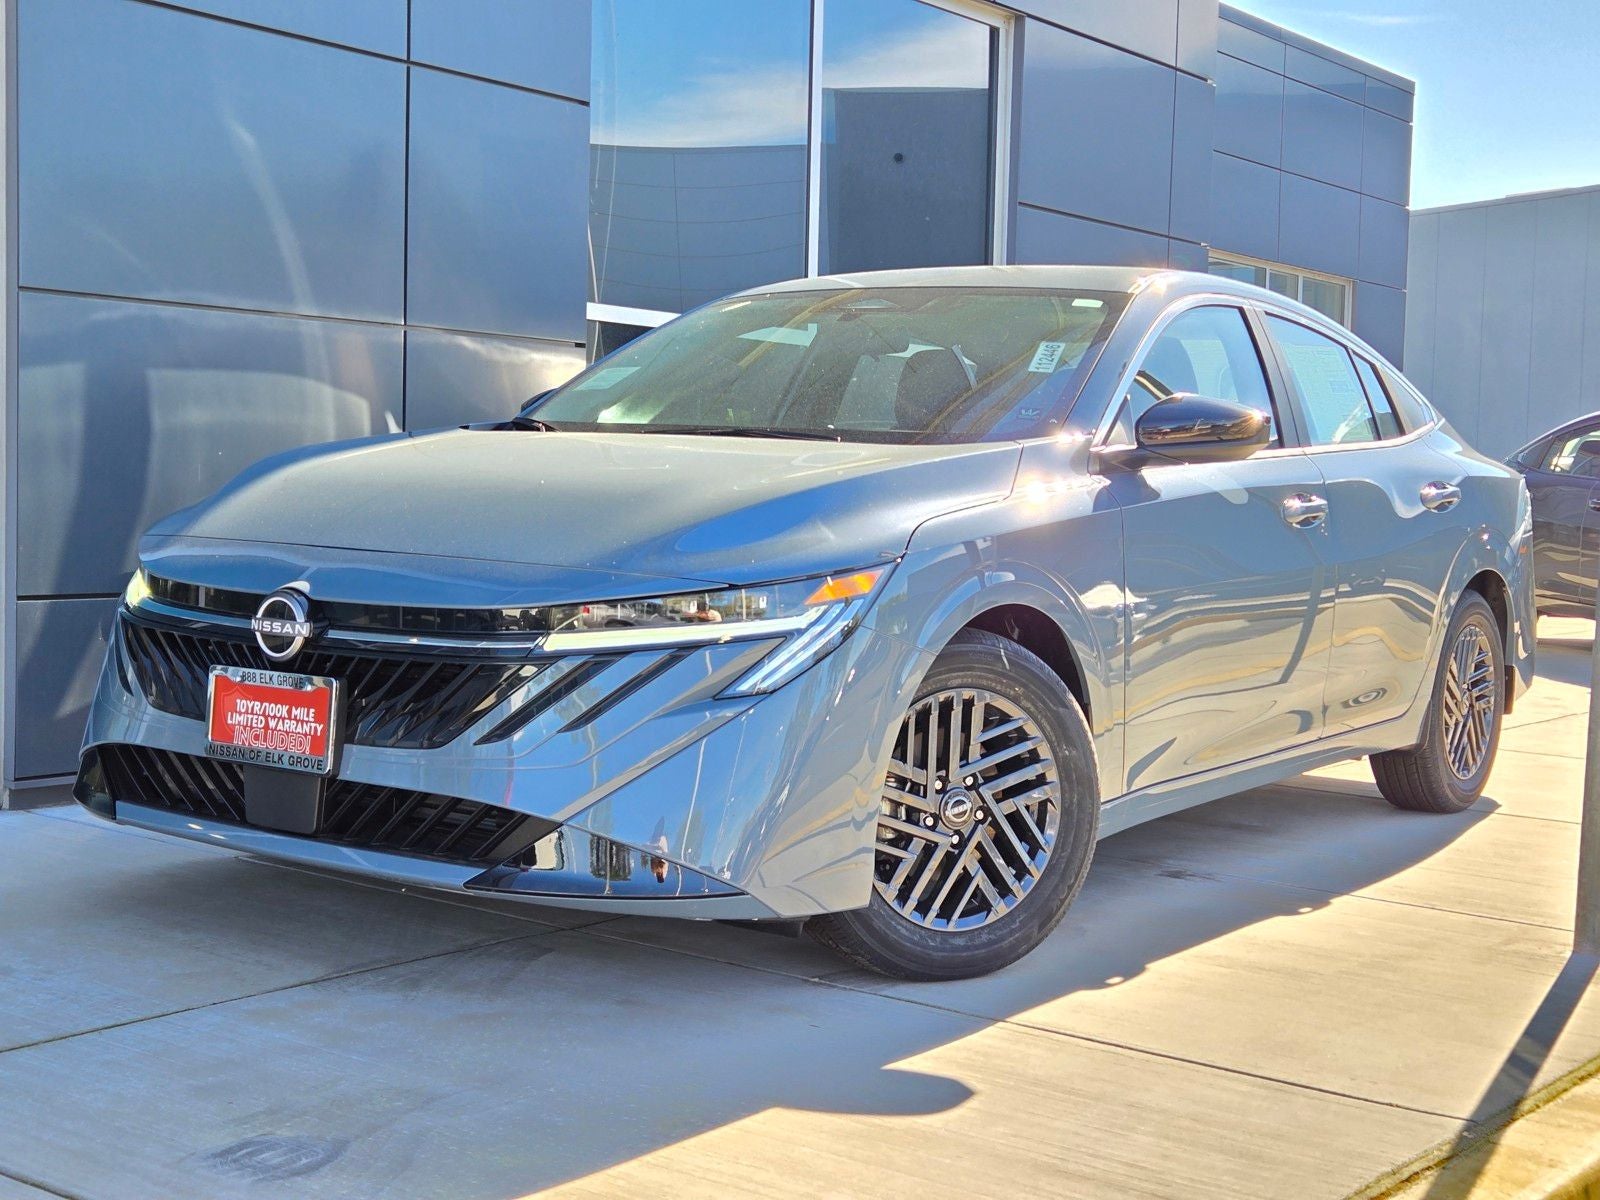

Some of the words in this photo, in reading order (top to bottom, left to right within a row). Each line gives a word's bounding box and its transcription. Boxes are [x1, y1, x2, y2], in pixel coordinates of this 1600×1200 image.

[251, 619, 307, 635] NISSAN
[260, 673, 275, 686] ELK
[277, 674, 304, 689] GROVE
[236, 699, 290, 718] 10YR/100K
[291, 706, 316, 722] MILE
[227, 711, 266, 728] LIMITED
[268, 716, 323, 736] WARRANTY
[233, 725, 312, 754] INCLUDED!
[208, 743, 245, 760] NISSAN
[249, 750, 262, 760] OF
[265, 752, 285, 765] ELK
[288, 755, 323, 771] GROVE
